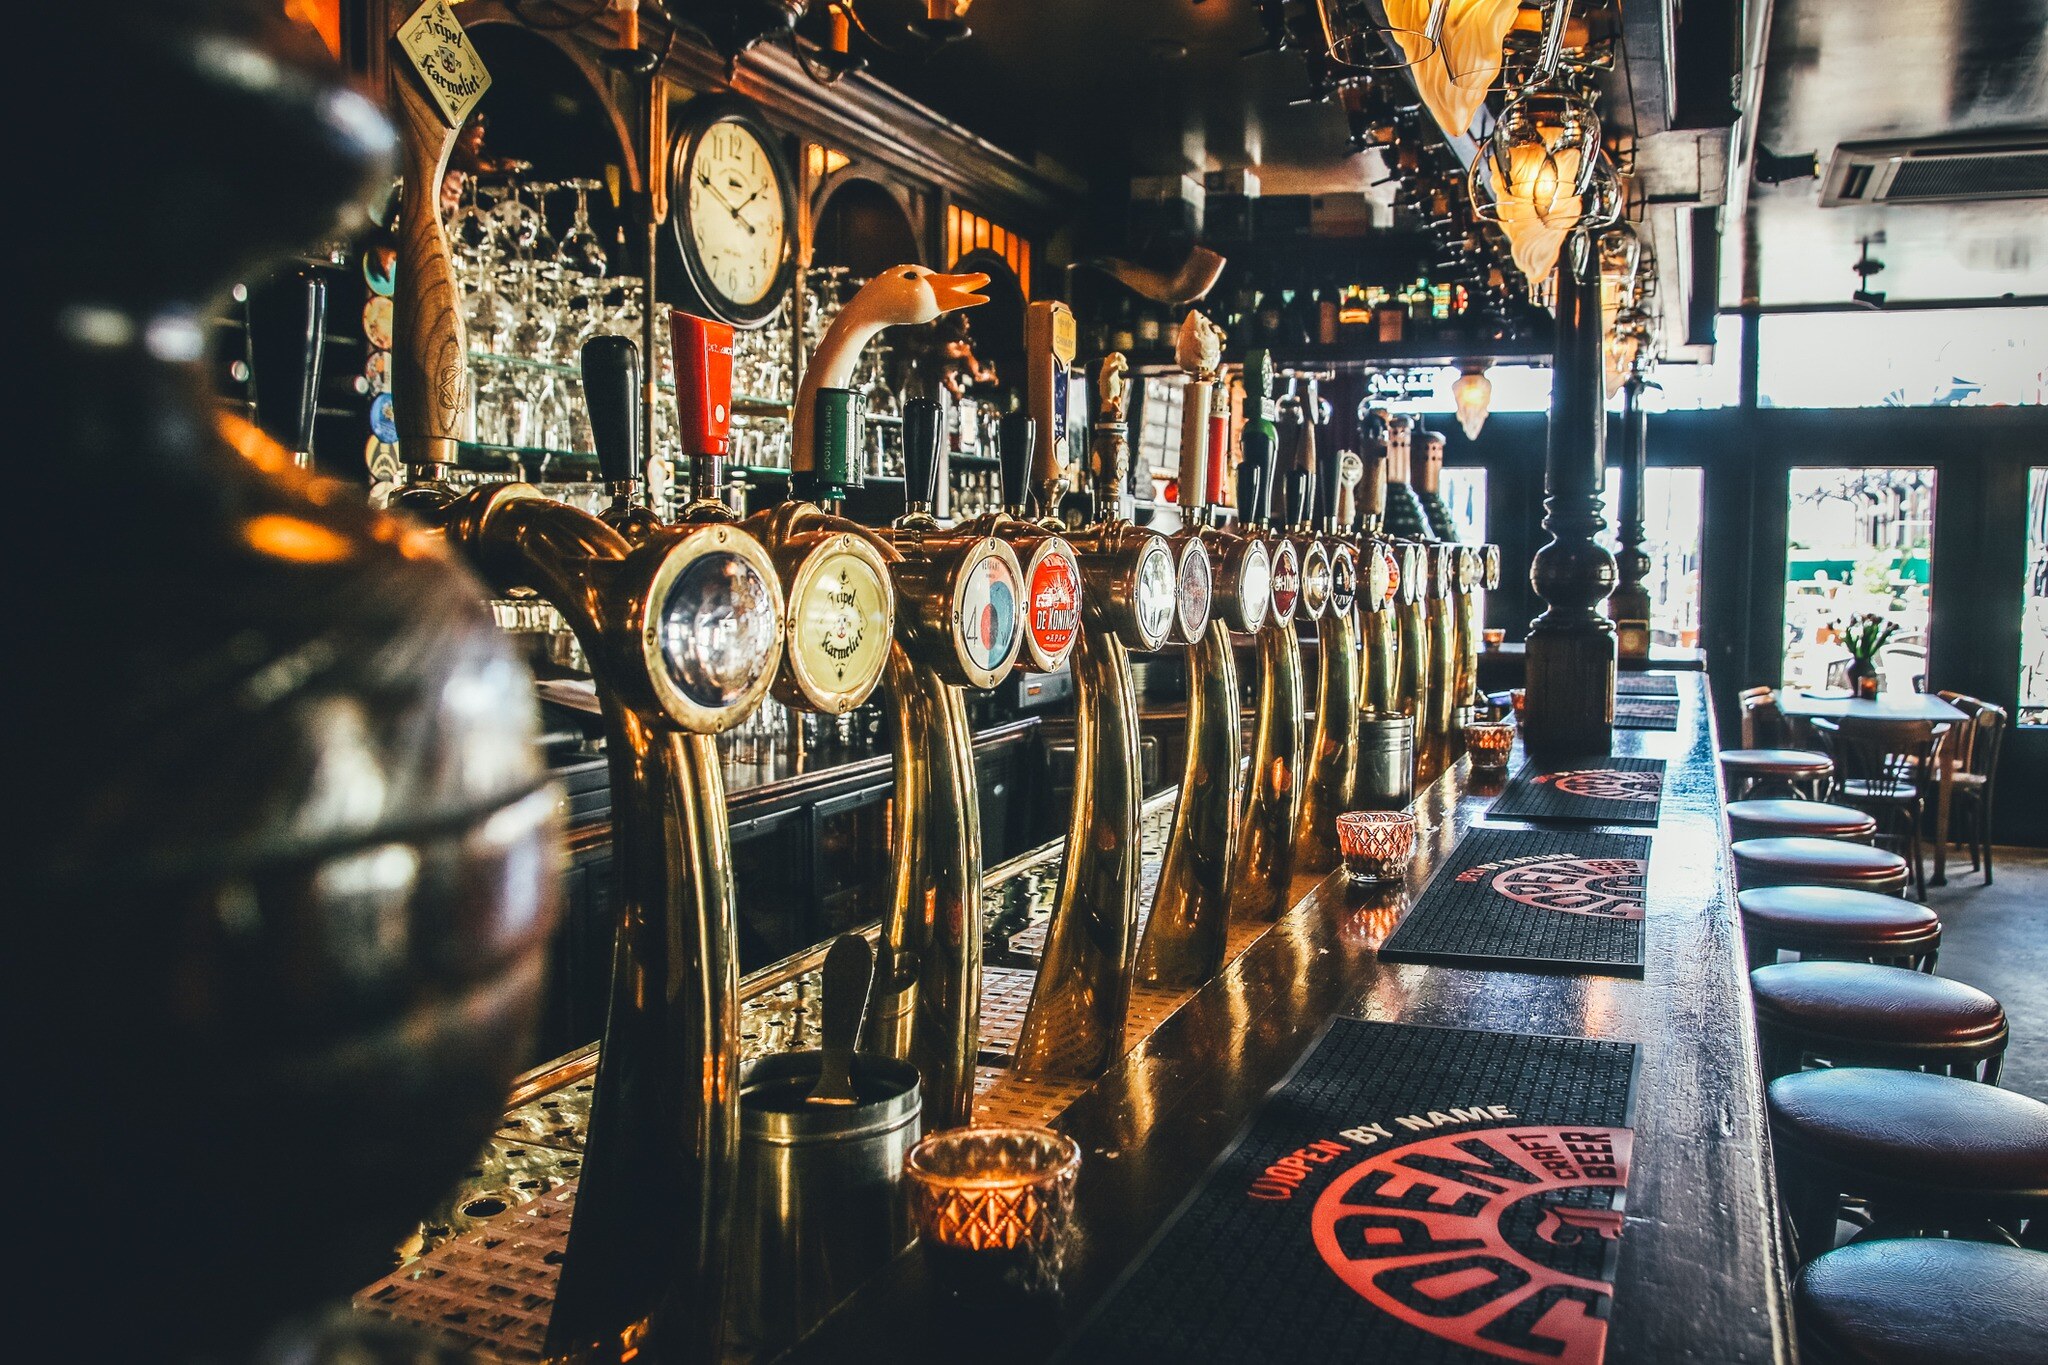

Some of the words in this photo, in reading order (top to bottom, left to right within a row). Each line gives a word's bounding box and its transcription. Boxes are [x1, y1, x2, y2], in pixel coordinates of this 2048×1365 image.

[421, 14, 463, 48] Tripel
[418, 53, 480, 97] Karmeliet
[713, 135, 723, 161] 11
[729, 134, 742, 160] 12
[751, 150, 756, 174] 1
[767, 214, 775, 237] 3
[711, 256, 719, 279] 7
[760, 248, 768, 269] 4
[728, 268, 737, 292] 6
[747, 266, 756, 288] 5
[824, 404, 833, 437] ISLAND
[823, 440, 832, 471] GOOSE
[1036, 610, 1048, 630] DE
[821, 629, 863, 660] Karmeliet
[1049, 634, 1062, 642] APA
[1339, 1122, 1394, 1145] BY
[1395, 1105, 1518, 1131] NAME
[1507, 1134, 1581, 1181] CRAFT
[1559, 1131, 1618, 1179] BEER
